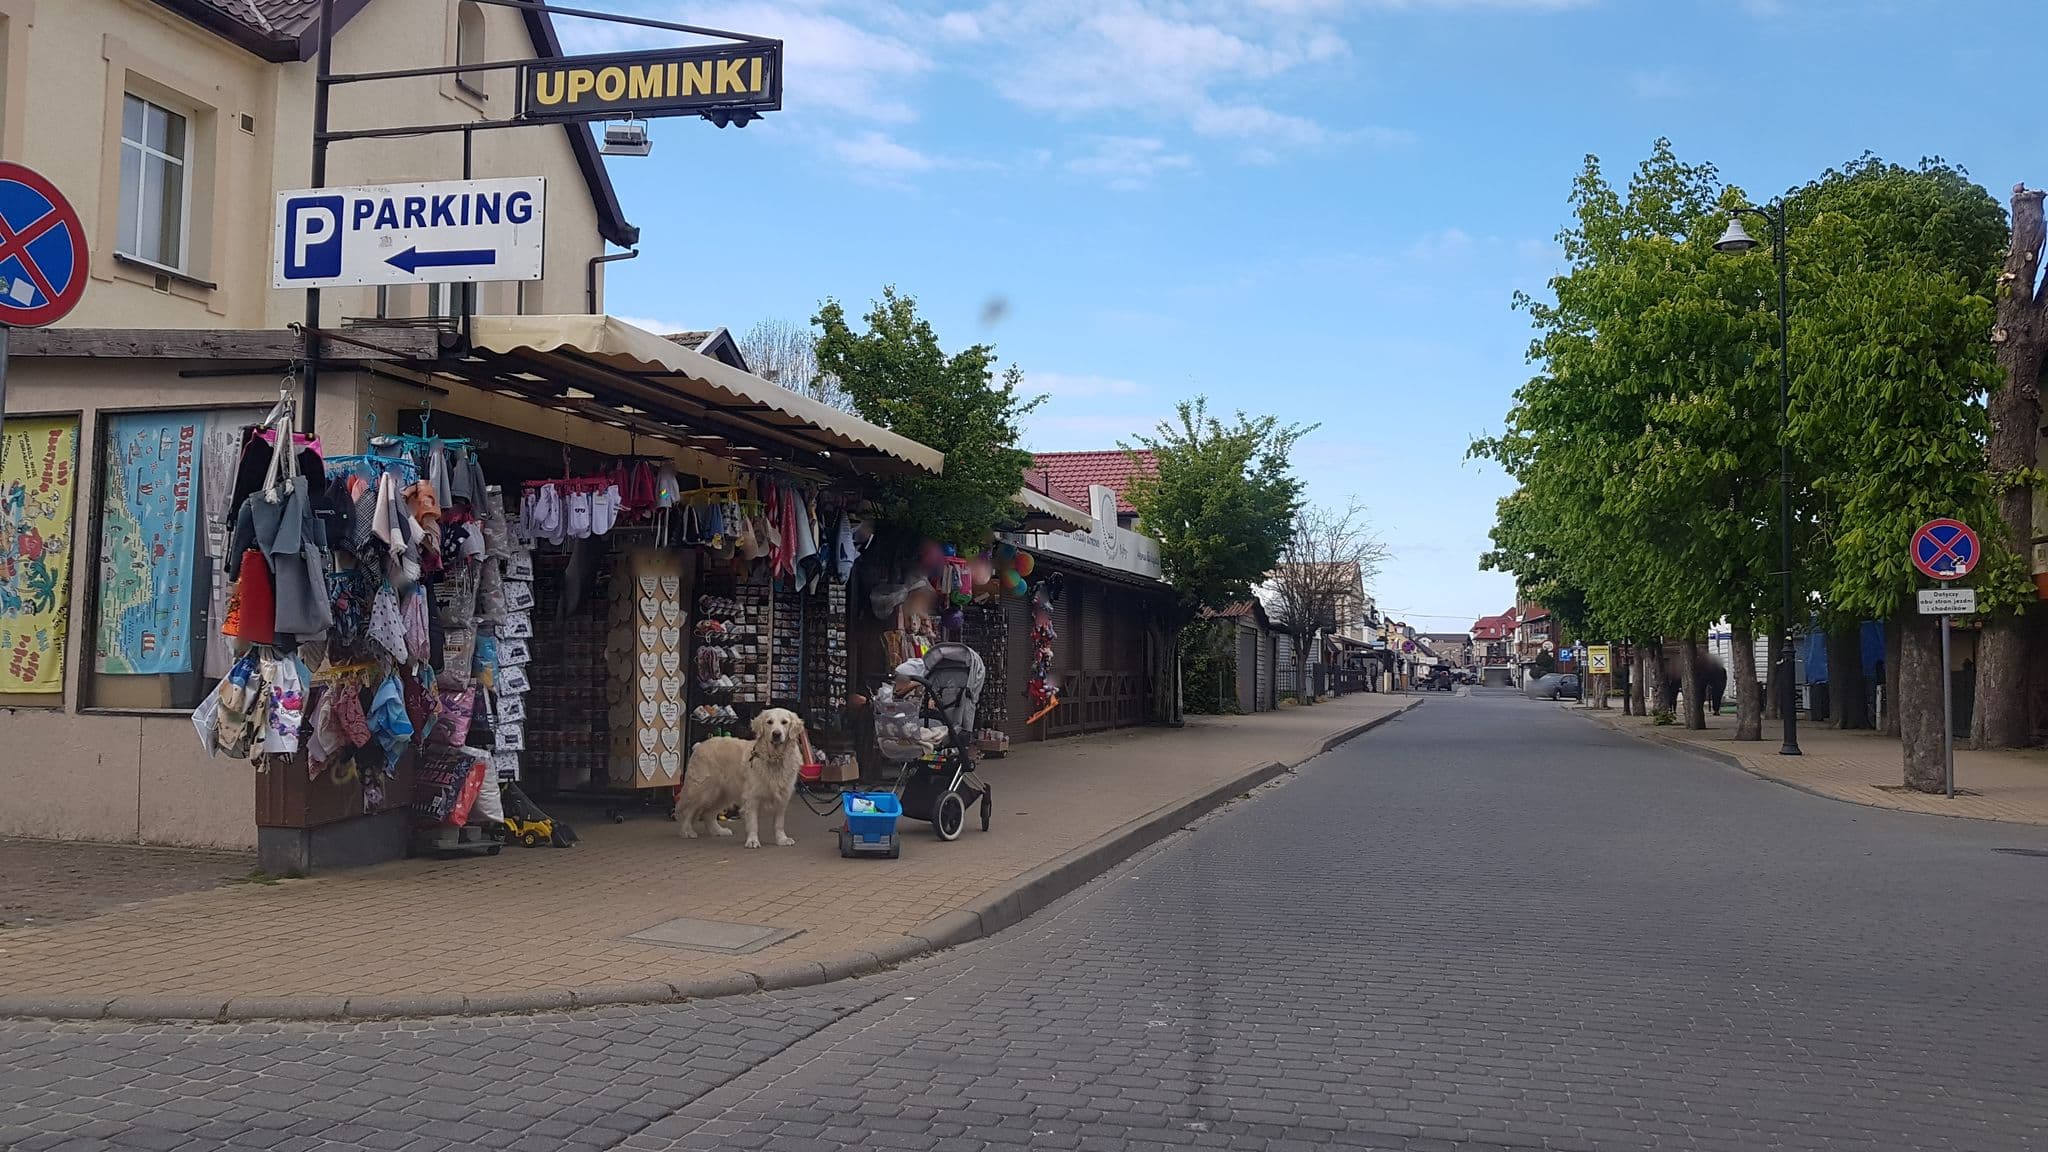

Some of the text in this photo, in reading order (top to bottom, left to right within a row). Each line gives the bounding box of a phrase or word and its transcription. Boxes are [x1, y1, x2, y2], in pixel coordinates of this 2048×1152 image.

[535, 56, 764, 106] UPOMINKI
[352, 190, 533, 231] PARKING
[294, 206, 336, 267] P
[1561, 649, 1568, 658] P
